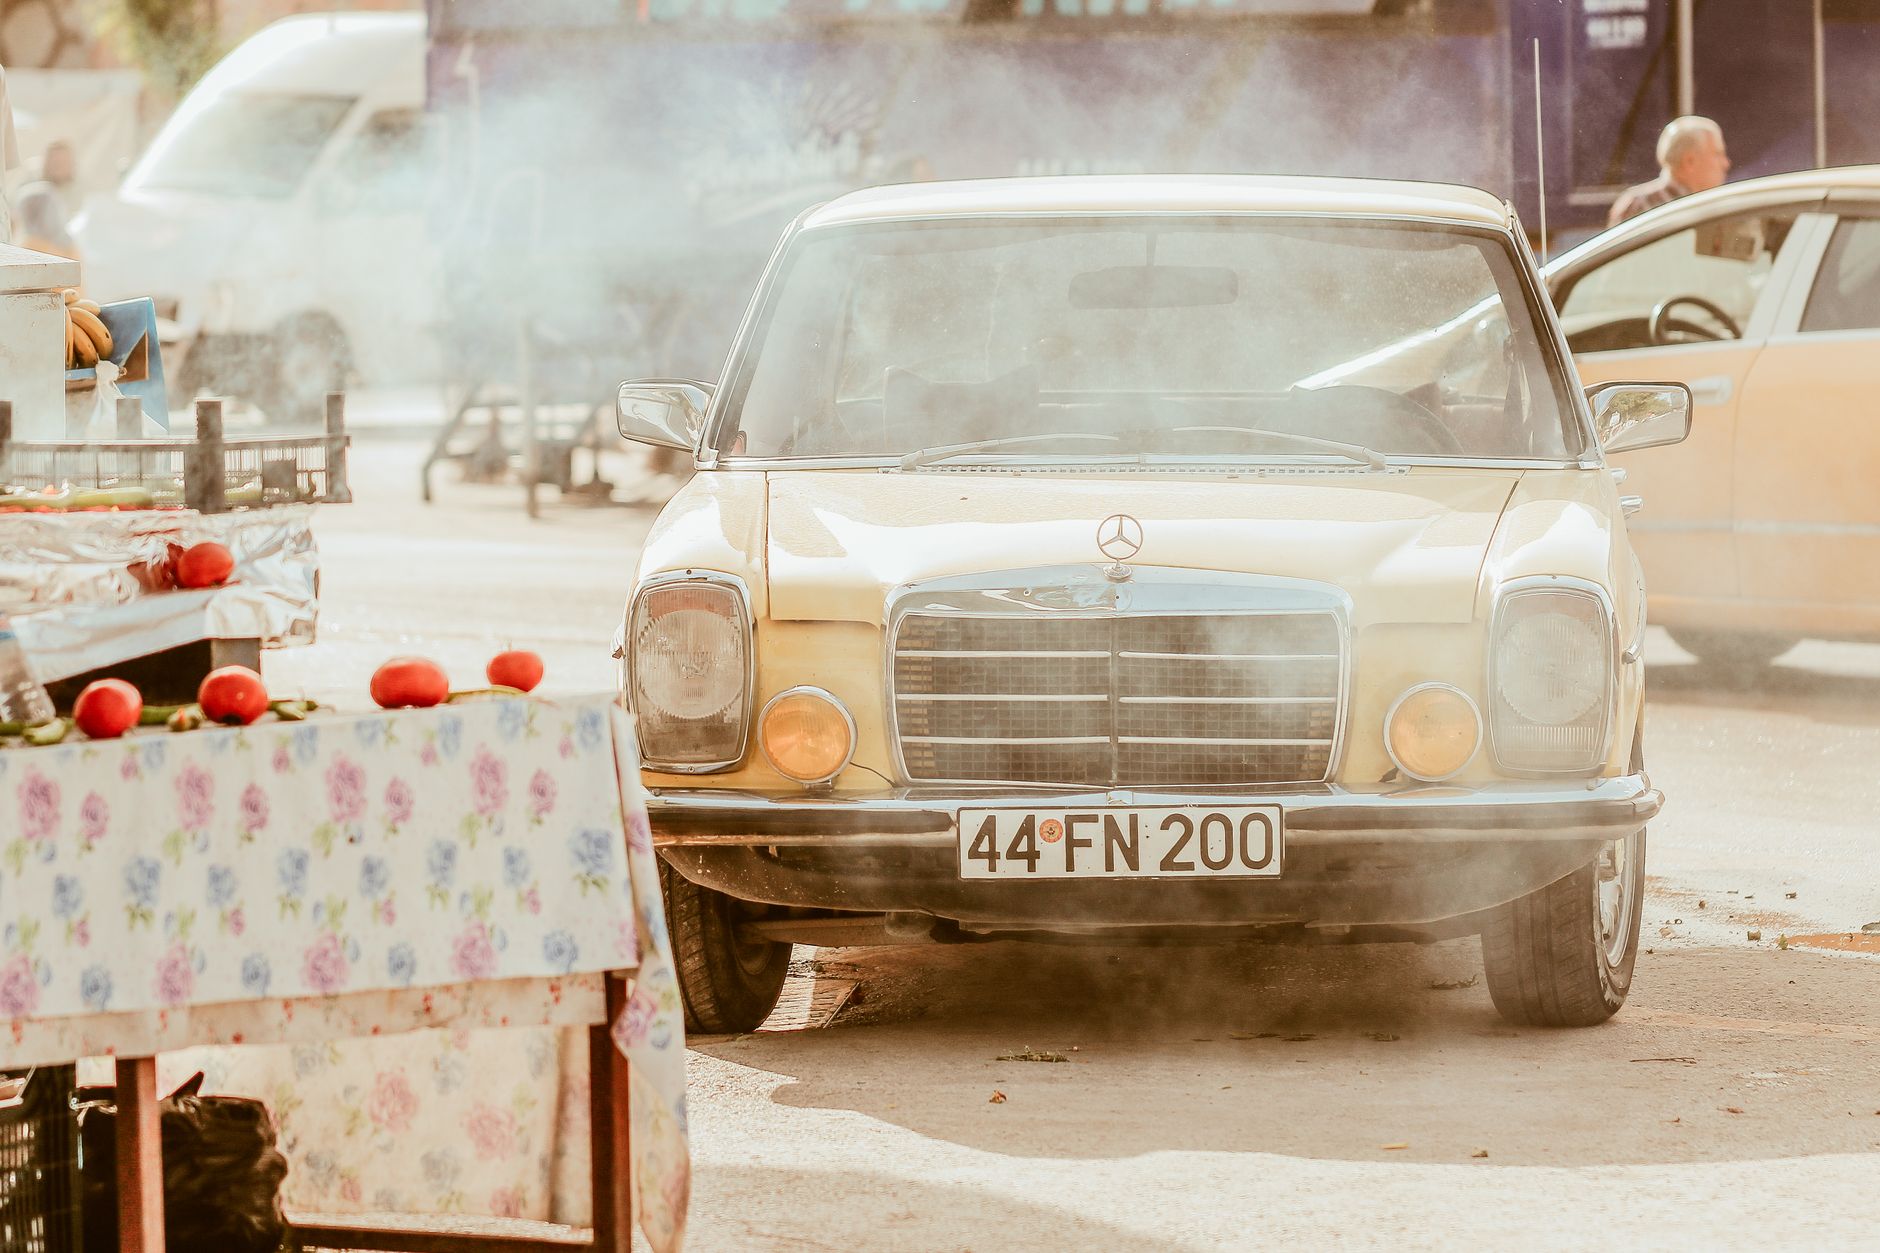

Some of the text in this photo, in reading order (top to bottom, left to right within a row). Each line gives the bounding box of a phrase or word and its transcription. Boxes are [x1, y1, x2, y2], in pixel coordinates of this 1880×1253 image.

[968, 812, 1273, 872] 44 FN 200
